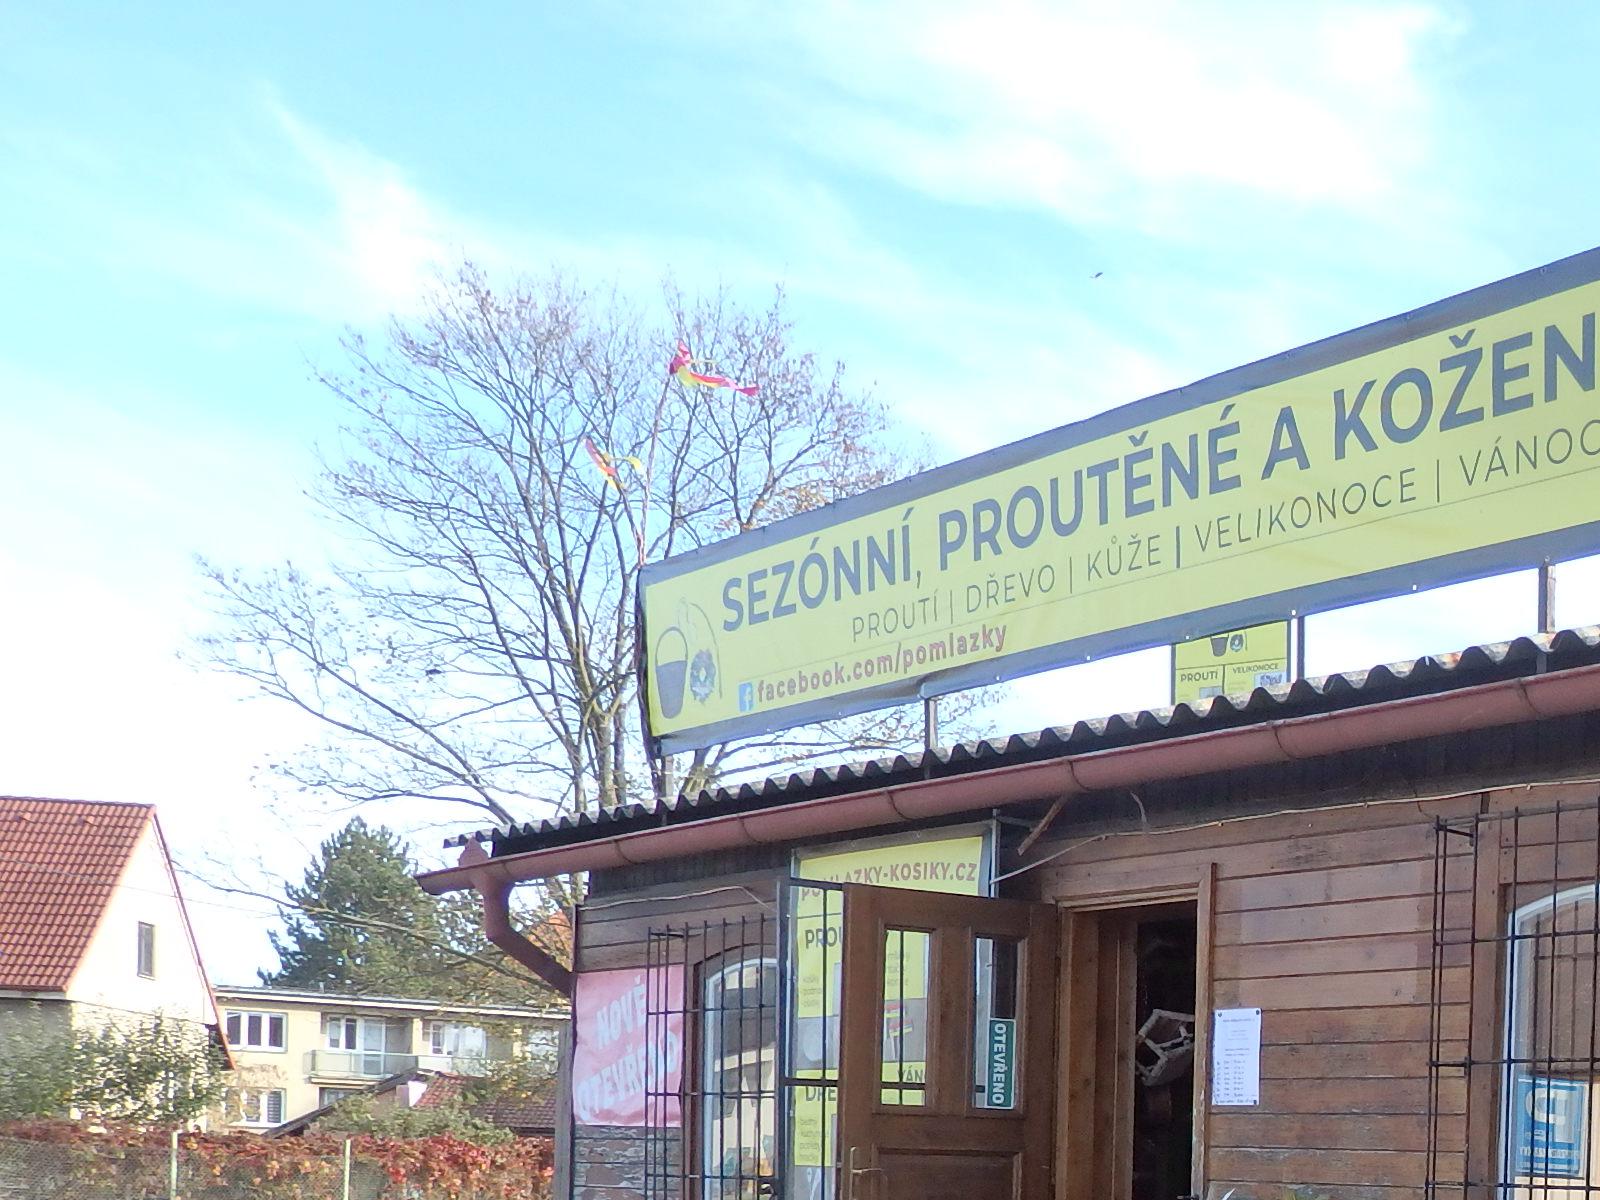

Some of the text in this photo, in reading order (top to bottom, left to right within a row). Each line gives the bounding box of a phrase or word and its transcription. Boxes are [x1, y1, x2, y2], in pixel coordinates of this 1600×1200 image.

[723, 507, 921, 632] SEZÓNNÍ,
[939, 404, 1241, 571] PROUTĚNÉ
[1261, 405, 1310, 480] A
[852, 589, 939, 642] PROUTÍ
[966, 564, 1055, 614] DŘEVO
[1087, 534, 1161, 582] KŮŽE
[1194, 467, 1416, 553] VELIKONOCE
[757, 623, 1007, 703] facebook.com/pomlazky
[992, 1022, 1007, 1104] OTEVŘENO
